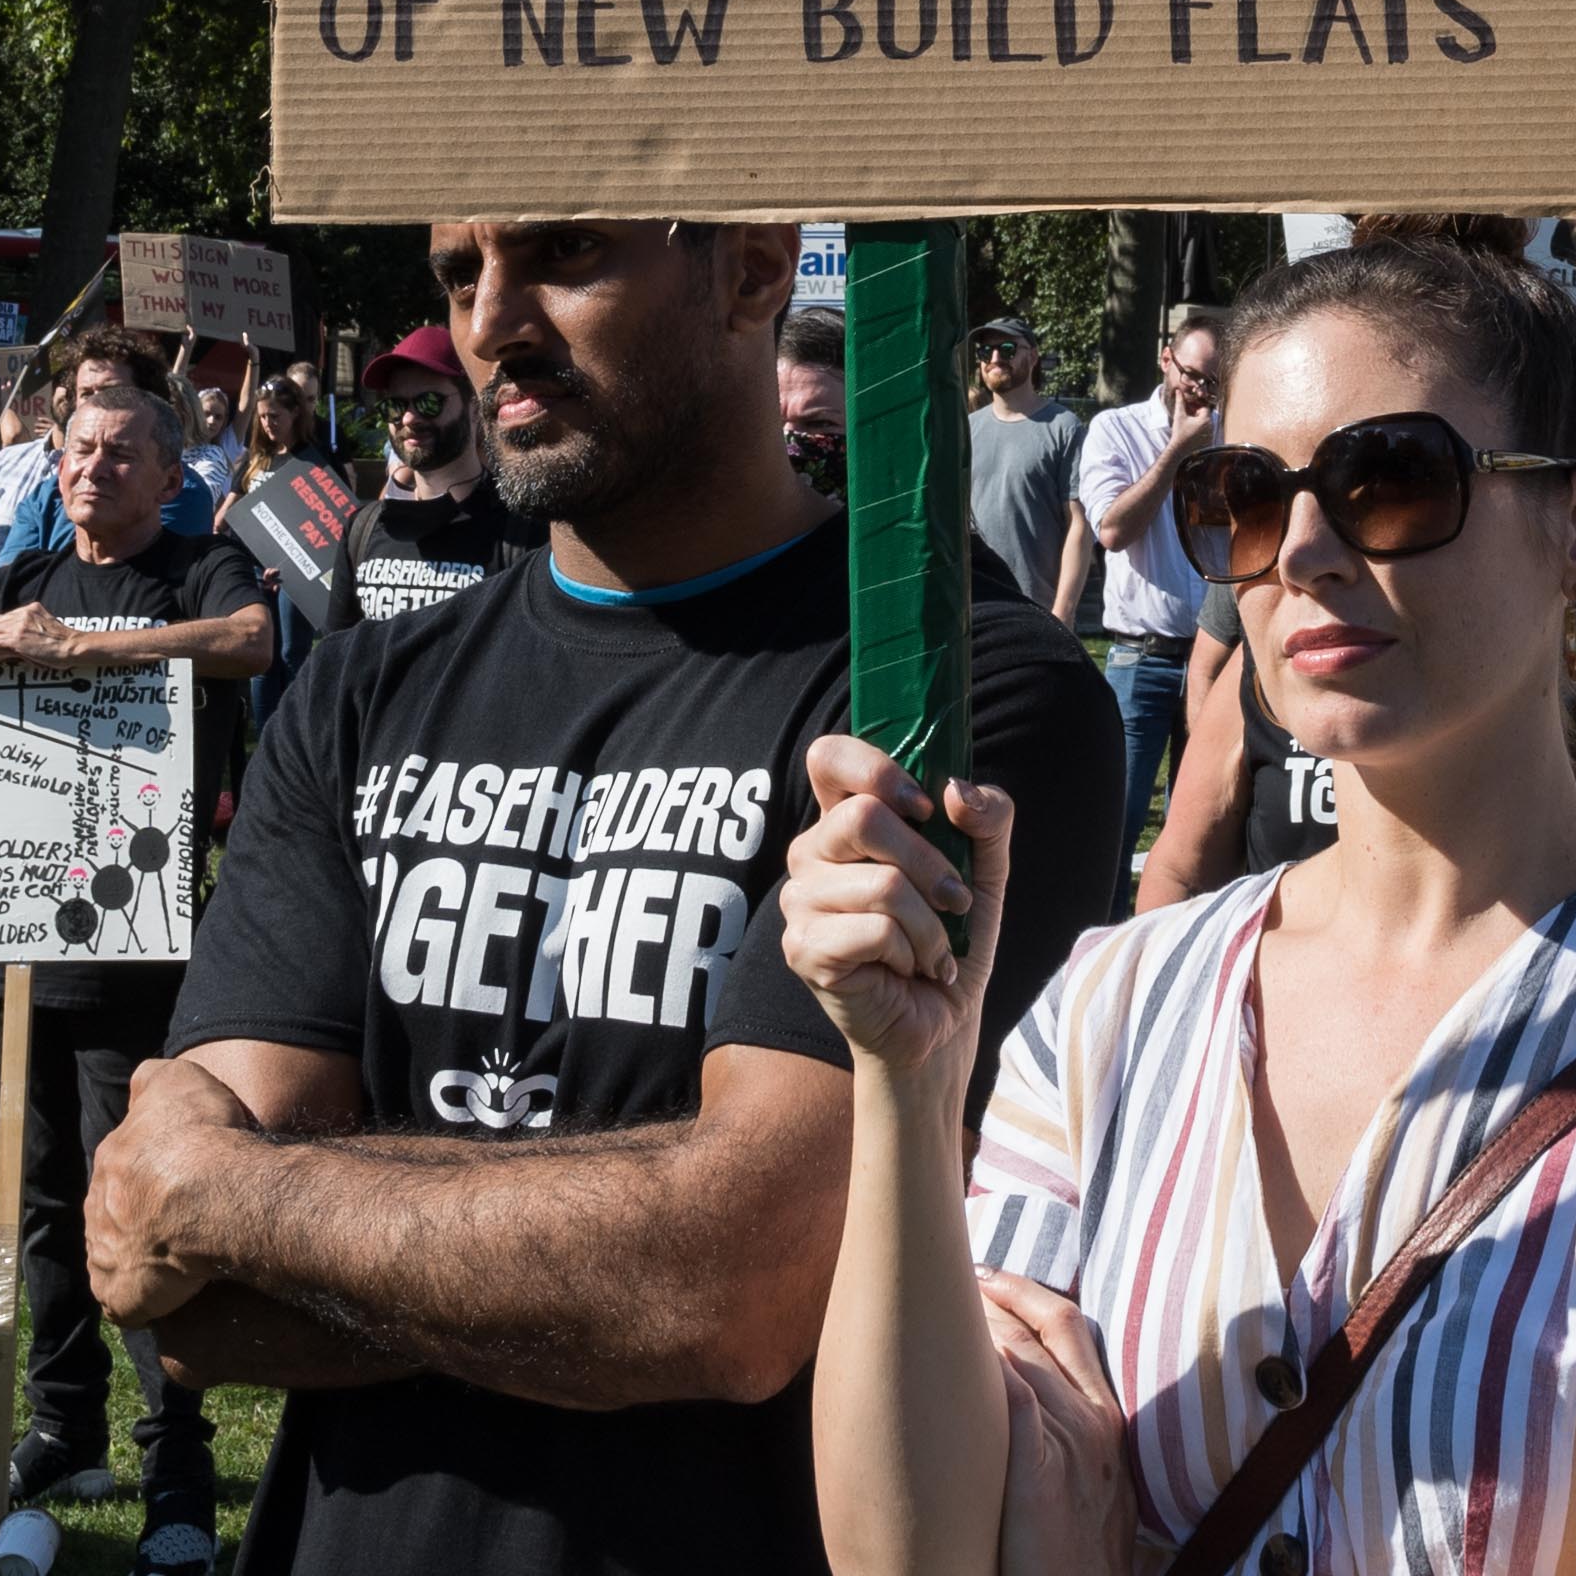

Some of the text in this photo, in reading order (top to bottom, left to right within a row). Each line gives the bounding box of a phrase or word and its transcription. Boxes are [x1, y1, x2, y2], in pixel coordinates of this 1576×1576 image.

[126, 240, 272, 272] THIS SIGN IS
[152, 269, 281, 297] WORTH MORE
[140, 295, 291, 332] THAN MY FLAT!
[309, 466, 349, 508] MAKE
[255, 503, 272, 522] NOT
[270, 521, 288, 541] THE
[286, 538, 316, 577] VICTIMS
[299, 520, 329, 549] PAY
[356, 558, 485, 589] #LEASEHOLDERS
[36, 696, 118, 720] LEASEHOLD
[116, 719, 176, 747] RIP OFF
[87, 765, 102, 857] DEVELOPERS
[177, 789, 195, 919] FREEHOLDERS
